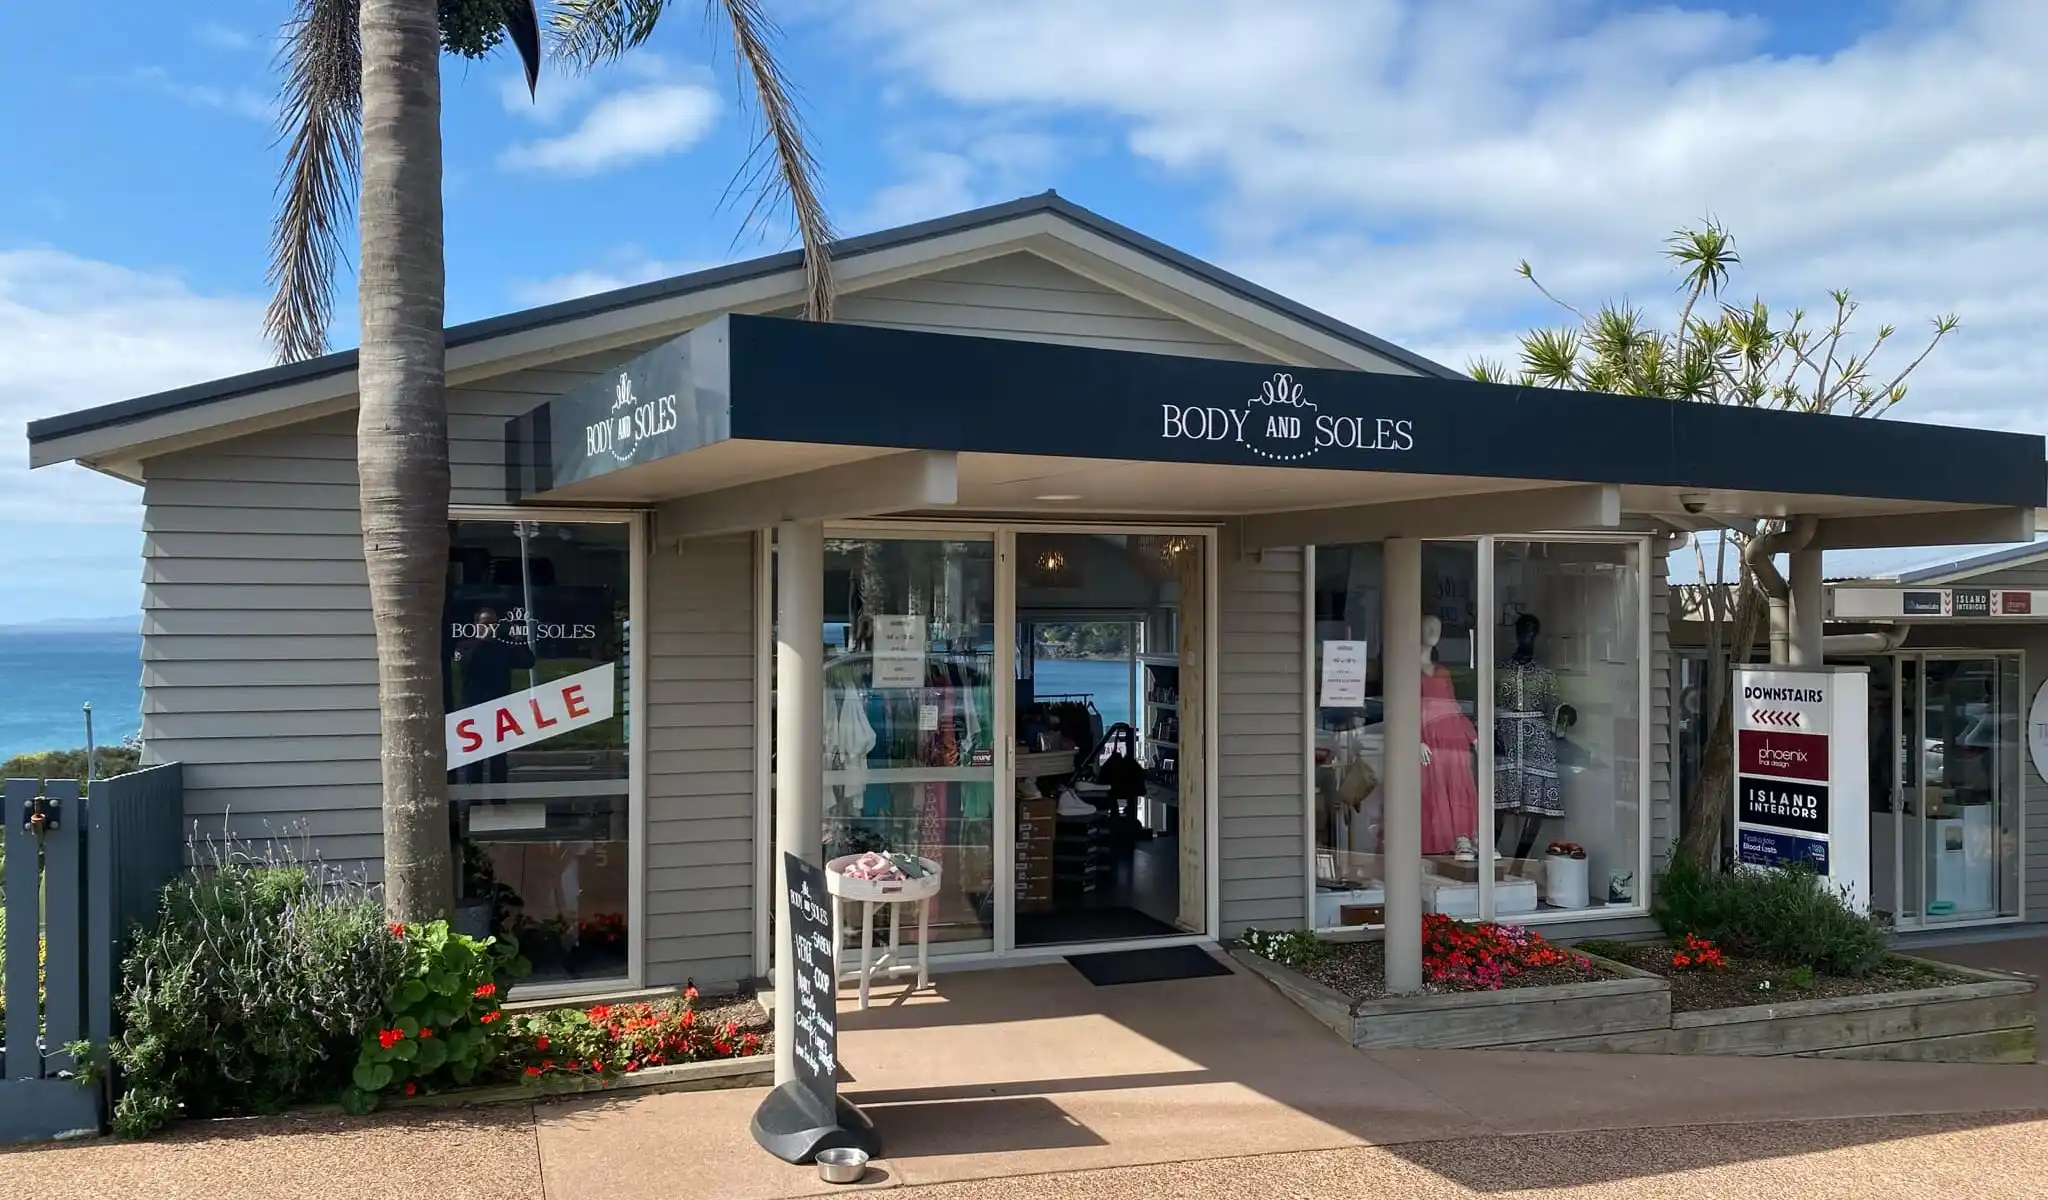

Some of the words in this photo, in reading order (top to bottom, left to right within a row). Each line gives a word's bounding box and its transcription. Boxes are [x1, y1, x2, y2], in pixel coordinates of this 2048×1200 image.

[586, 417, 614, 457] BODY
[617, 415, 631, 440] AND
[635, 394, 677, 441] SOLES
[1162, 404, 1250, 442] BODY
[1265, 415, 1300, 439] AND
[1315, 415, 1413, 450] SOLES
[1956, 595, 1986, 604] ISLAND
[452, 623, 500, 639] BODY
[509, 626, 529, 636] AND
[536, 624, 596, 639] SOLES
[1744, 686, 1823, 703] DOWNSTAIRS
[456, 684, 590, 753] SALE
[1758, 739, 1808, 762] phoenix
[1750, 788, 1817, 808] ISLAND
[1750, 801, 1817, 819] INTERIORS
[789, 888, 803, 910] BODY
[810, 902, 829, 926] SOLES
